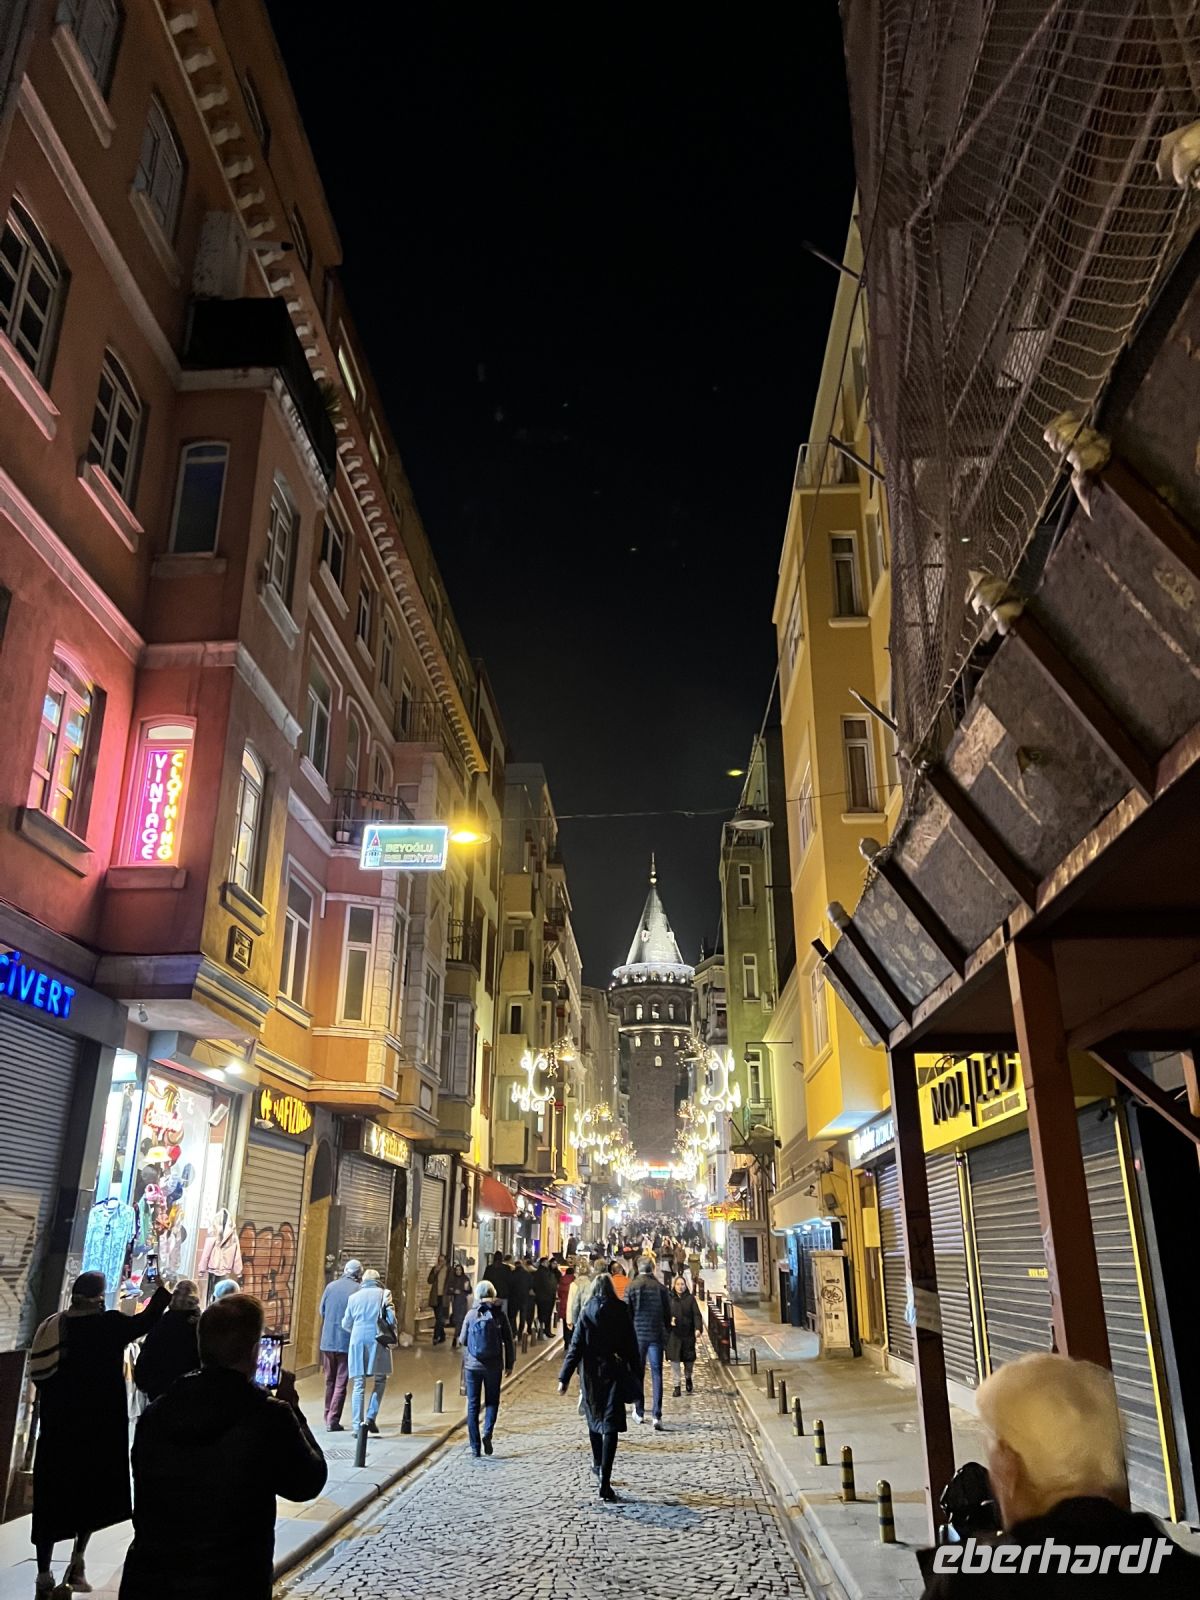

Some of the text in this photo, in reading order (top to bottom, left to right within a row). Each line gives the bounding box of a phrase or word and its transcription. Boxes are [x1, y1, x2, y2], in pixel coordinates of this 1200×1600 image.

[141, 753, 168, 859] VINTAGE
[157, 753, 184, 859] CLOTHING
[383, 852, 442, 863] BELEDİYESİ
[385, 841, 434, 853] BEYOĞLU
